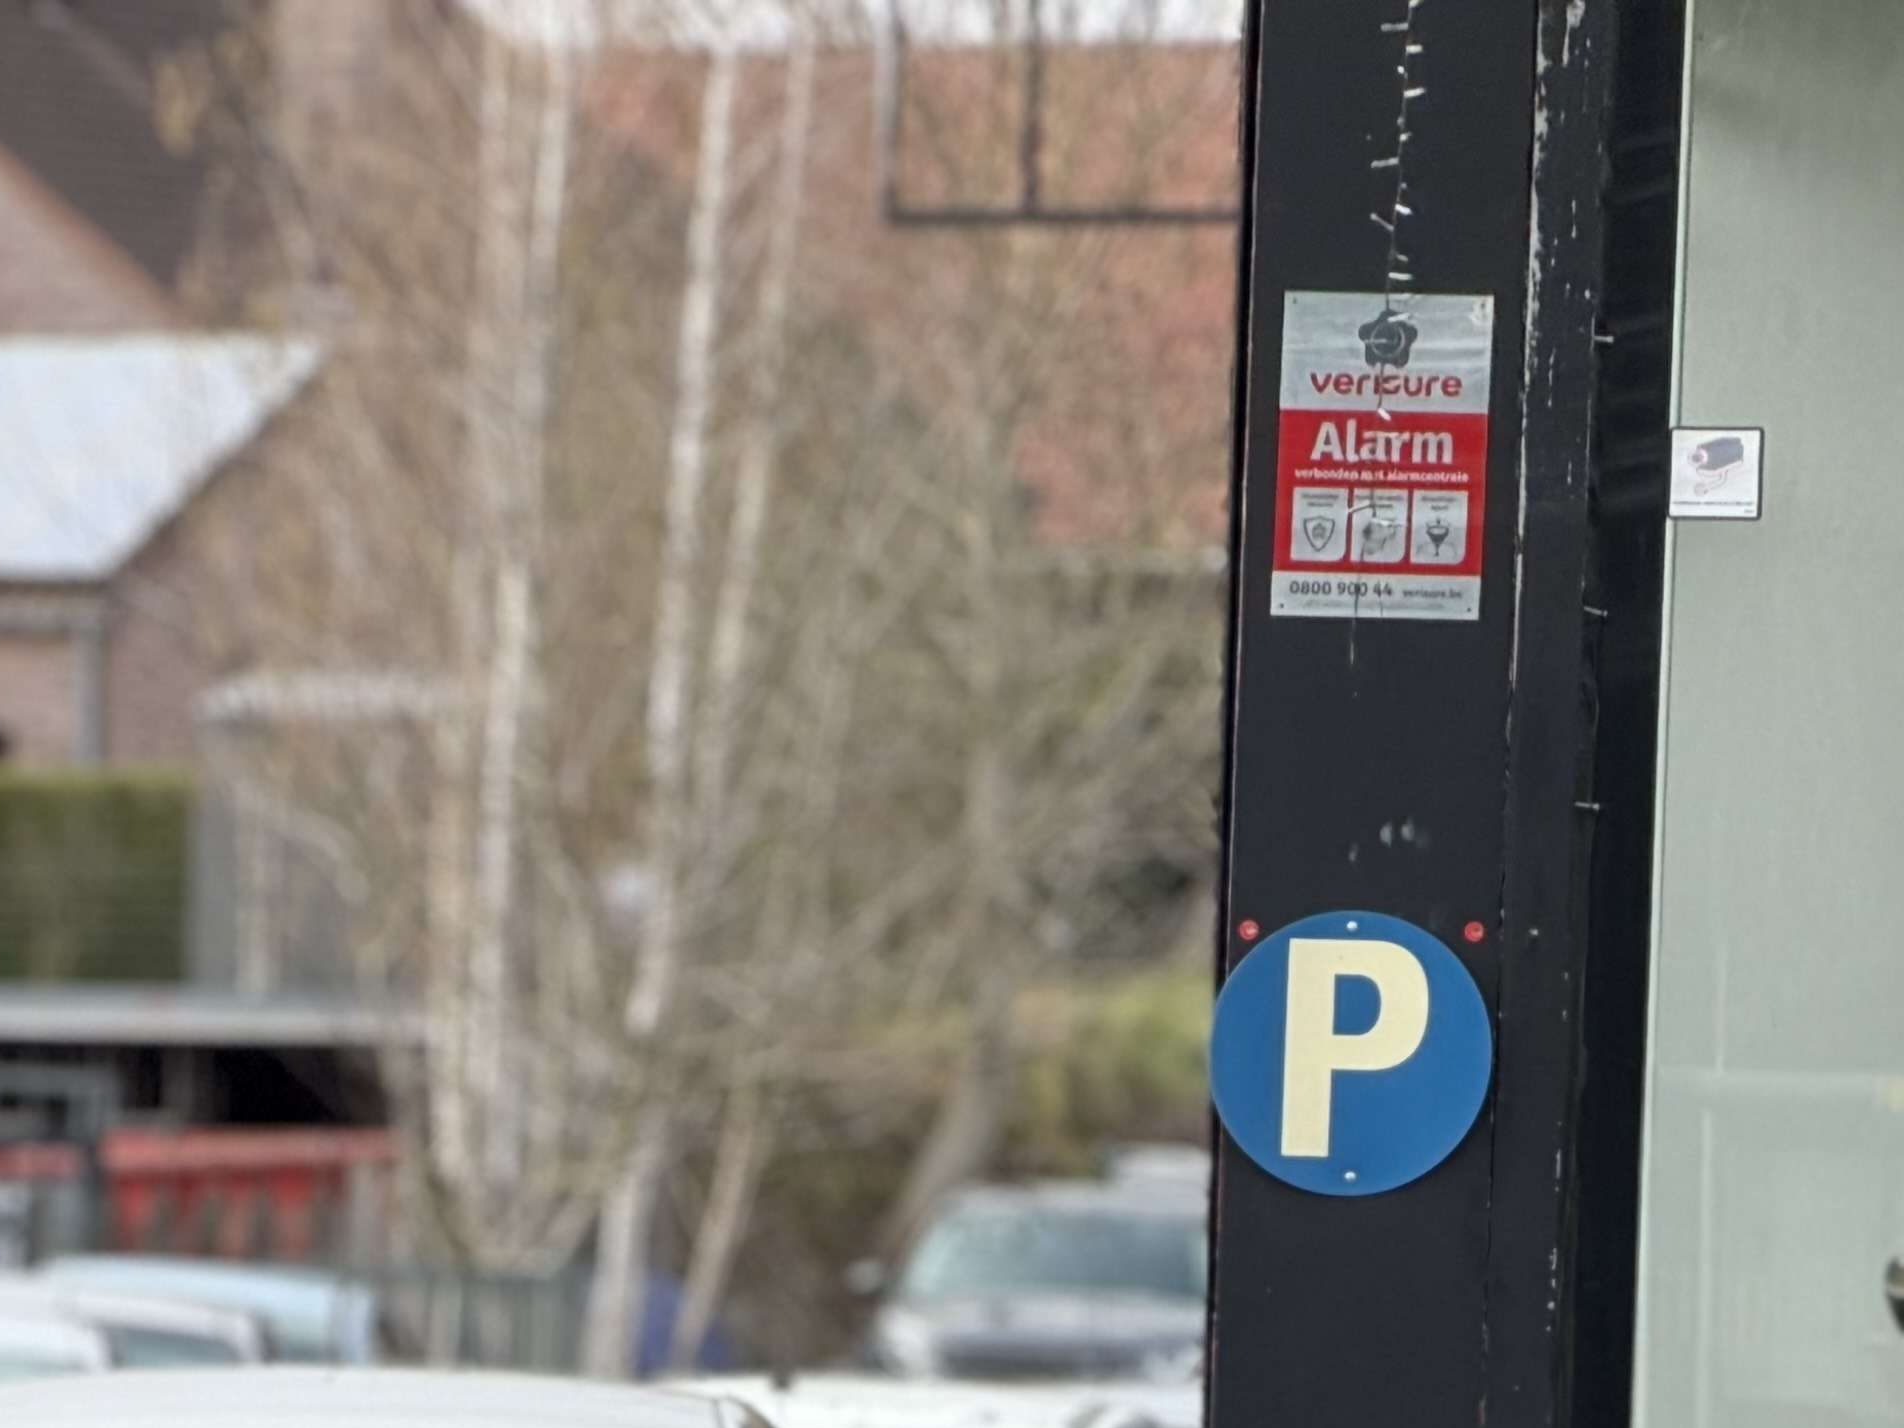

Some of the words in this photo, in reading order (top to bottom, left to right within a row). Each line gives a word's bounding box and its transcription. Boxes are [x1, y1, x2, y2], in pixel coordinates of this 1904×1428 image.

[1310, 419, 1453, 465] Alarm
[1289, 580, 1332, 596] 0800
[1280, 938, 1430, 1158] P
